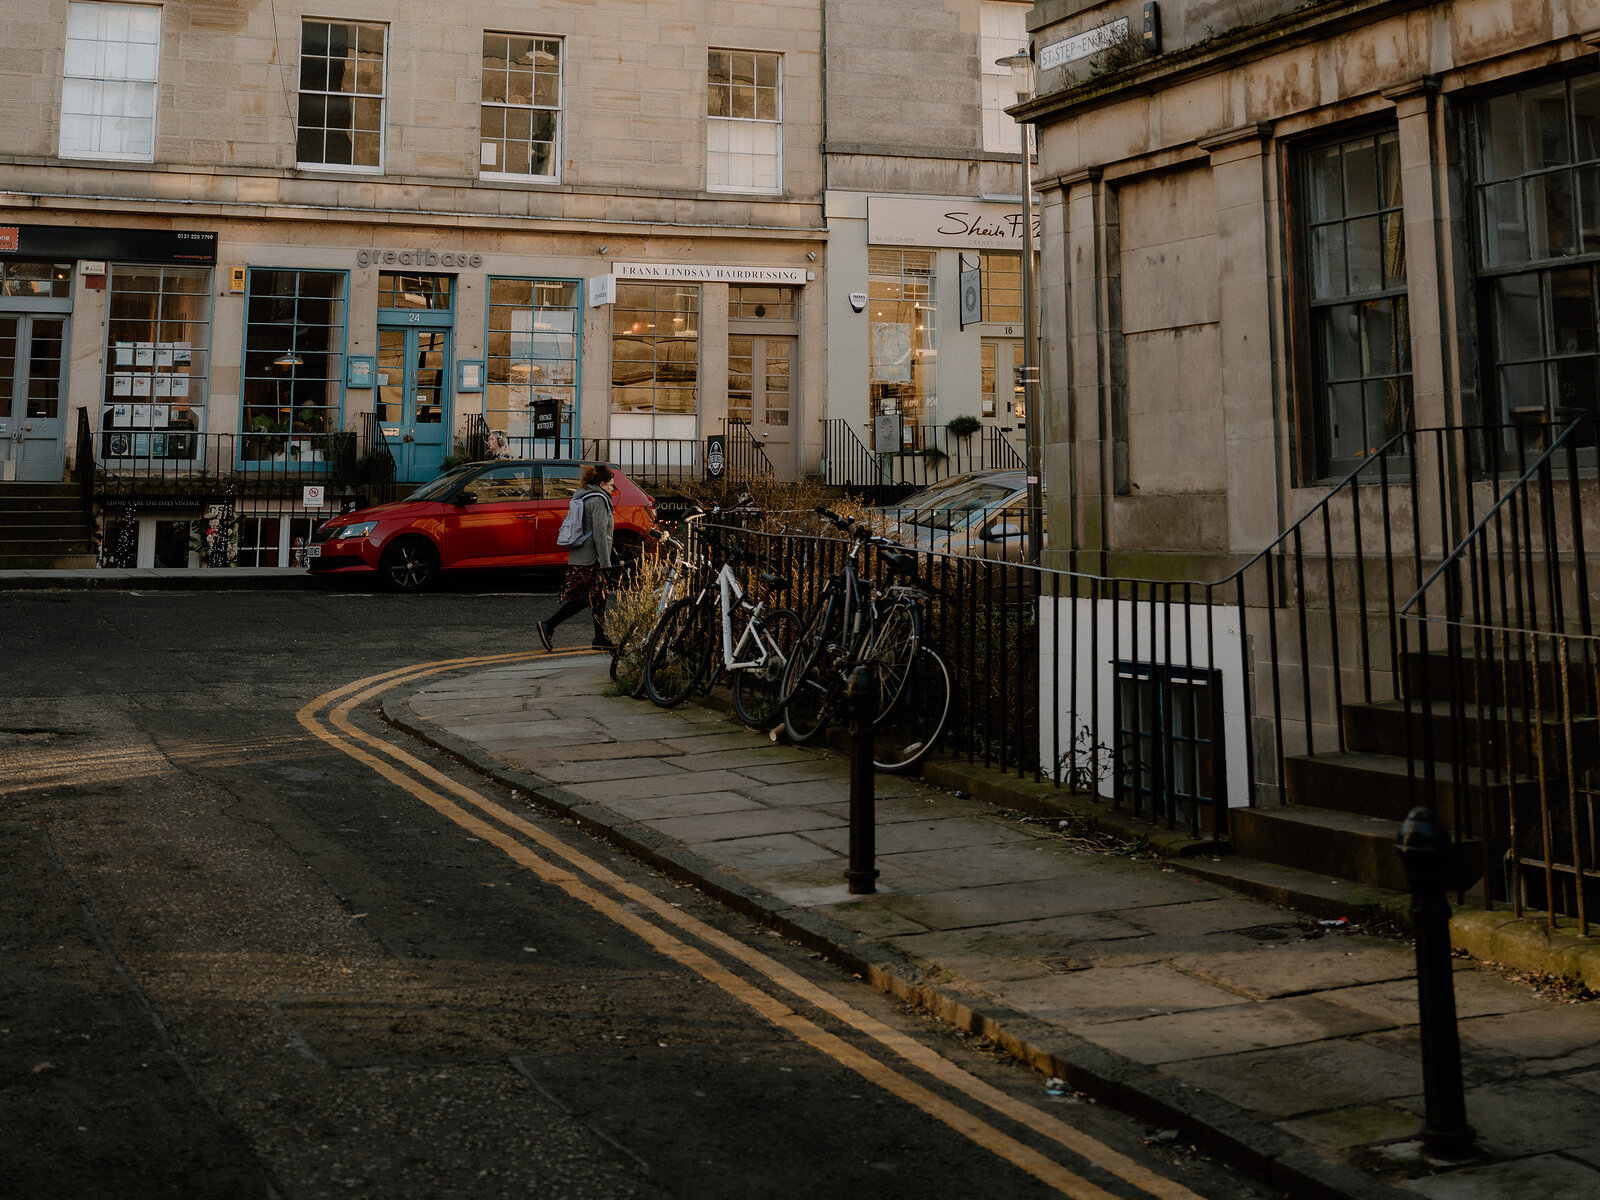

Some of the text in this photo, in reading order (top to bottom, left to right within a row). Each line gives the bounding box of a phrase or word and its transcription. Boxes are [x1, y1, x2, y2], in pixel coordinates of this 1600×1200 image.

[937, 212, 1005, 237] Sheila
[357, 248, 482, 268] greatbase
[623, 266, 797, 280] FRANK LINDSAY HAIRDRESSING
[408, 313, 420, 322] 24
[1005, 326, 1013, 335] 18
[655, 501, 688, 510] Donut
